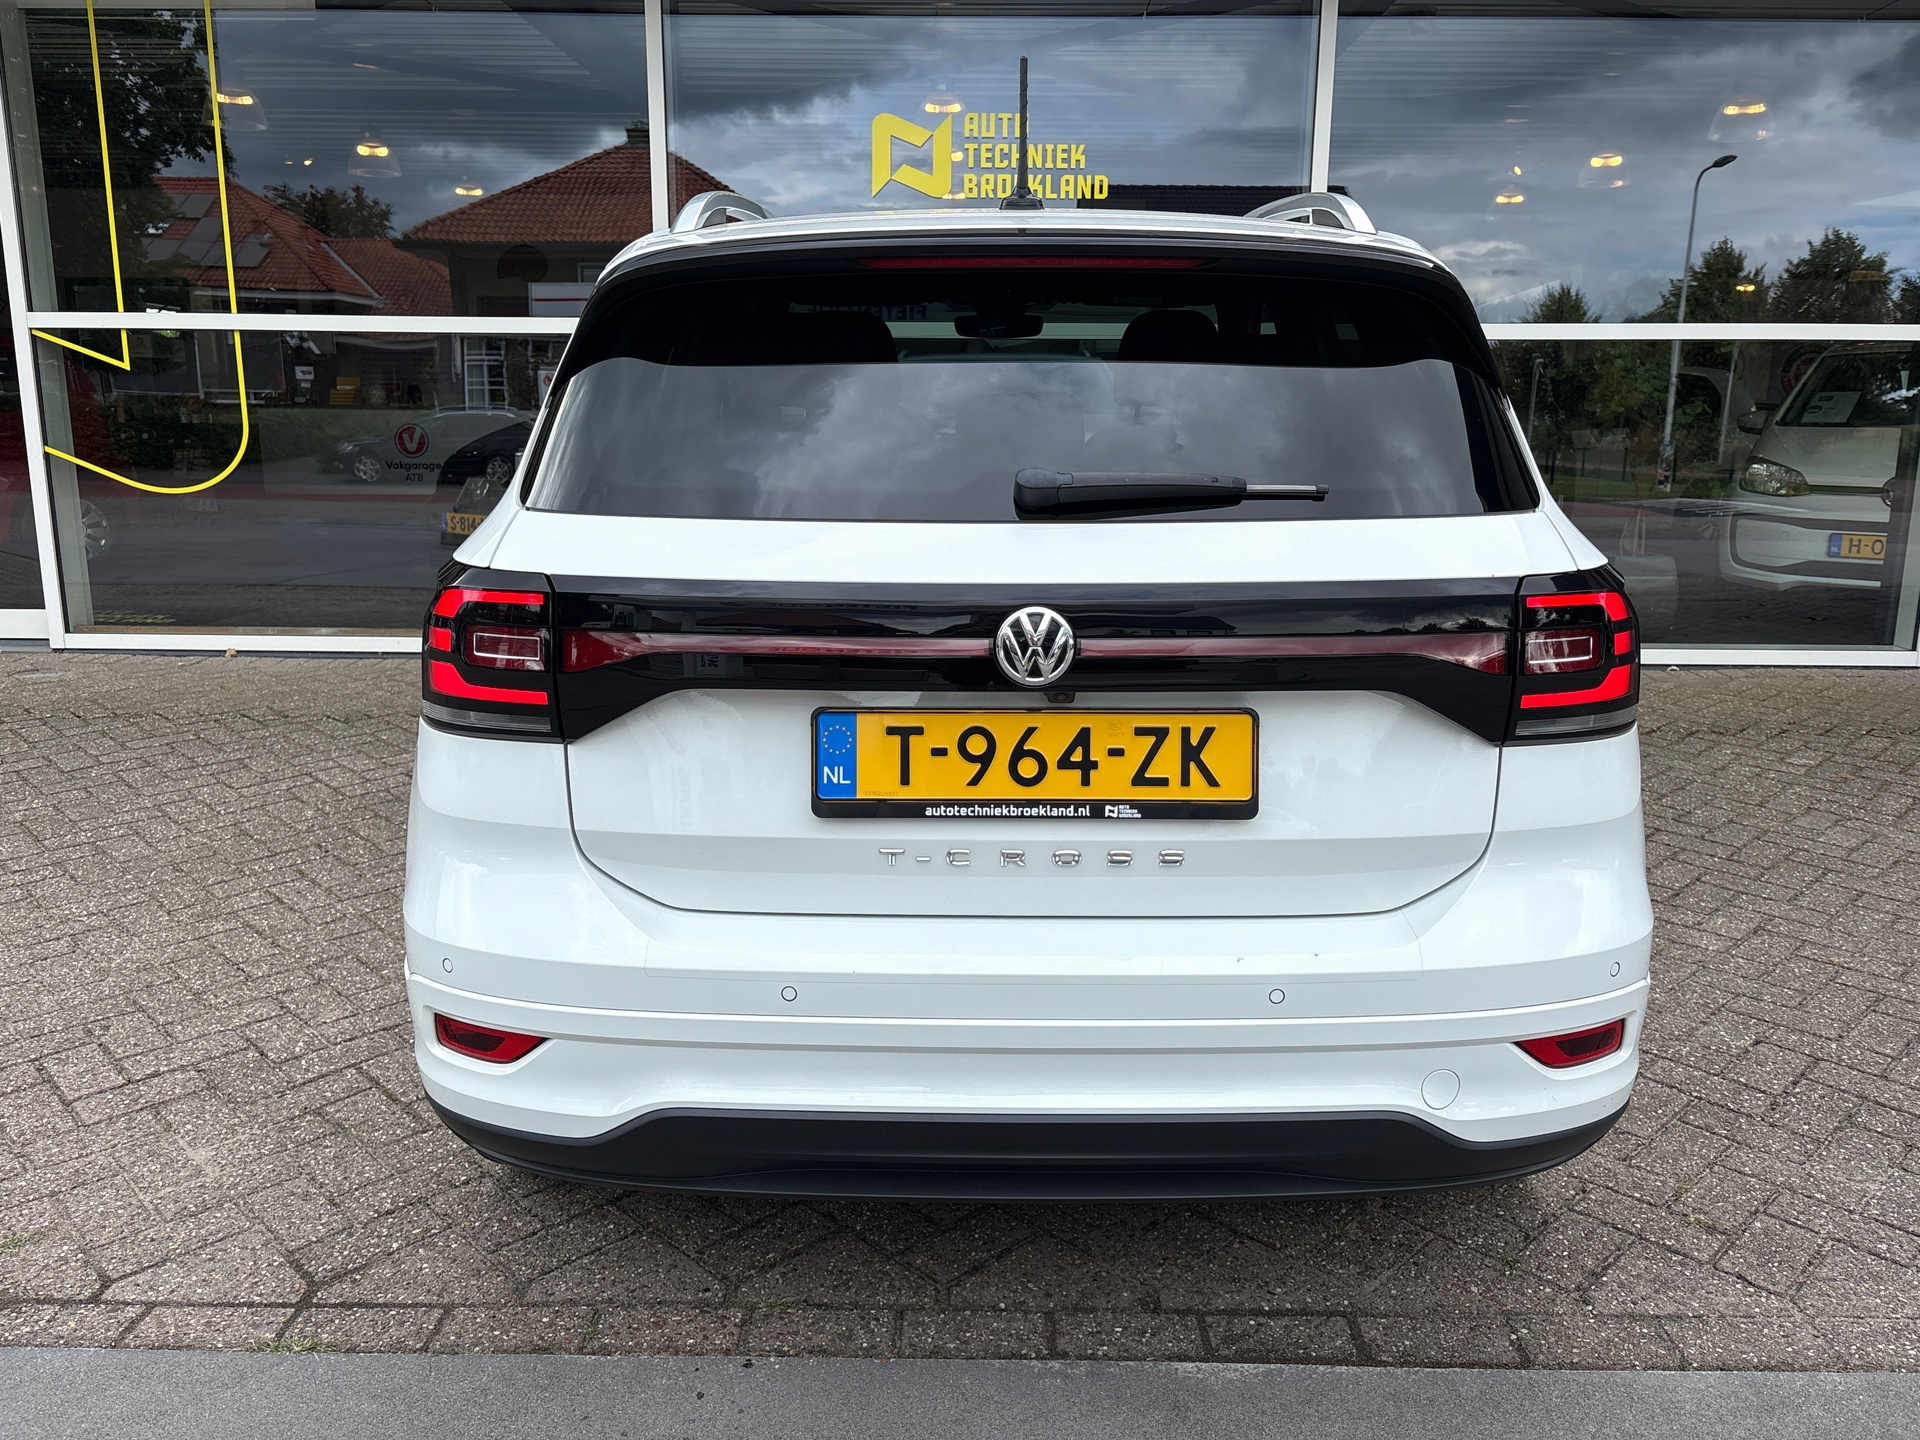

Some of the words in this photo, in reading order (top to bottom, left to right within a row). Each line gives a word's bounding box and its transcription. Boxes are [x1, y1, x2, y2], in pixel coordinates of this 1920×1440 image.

[964, 173, 1109, 200] BROKLAND
[385, 460, 442, 473] Vakgarage
[405, 473, 423, 482] ATB
[450, 515, 484, 532] S-814-
[823, 766, 851, 784] NL
[886, 726, 1221, 787] T-964-ZK
[925, 804, 1091, 816] autotechniekbroekland.nl
[878, 848, 1185, 867] T-CROSS
